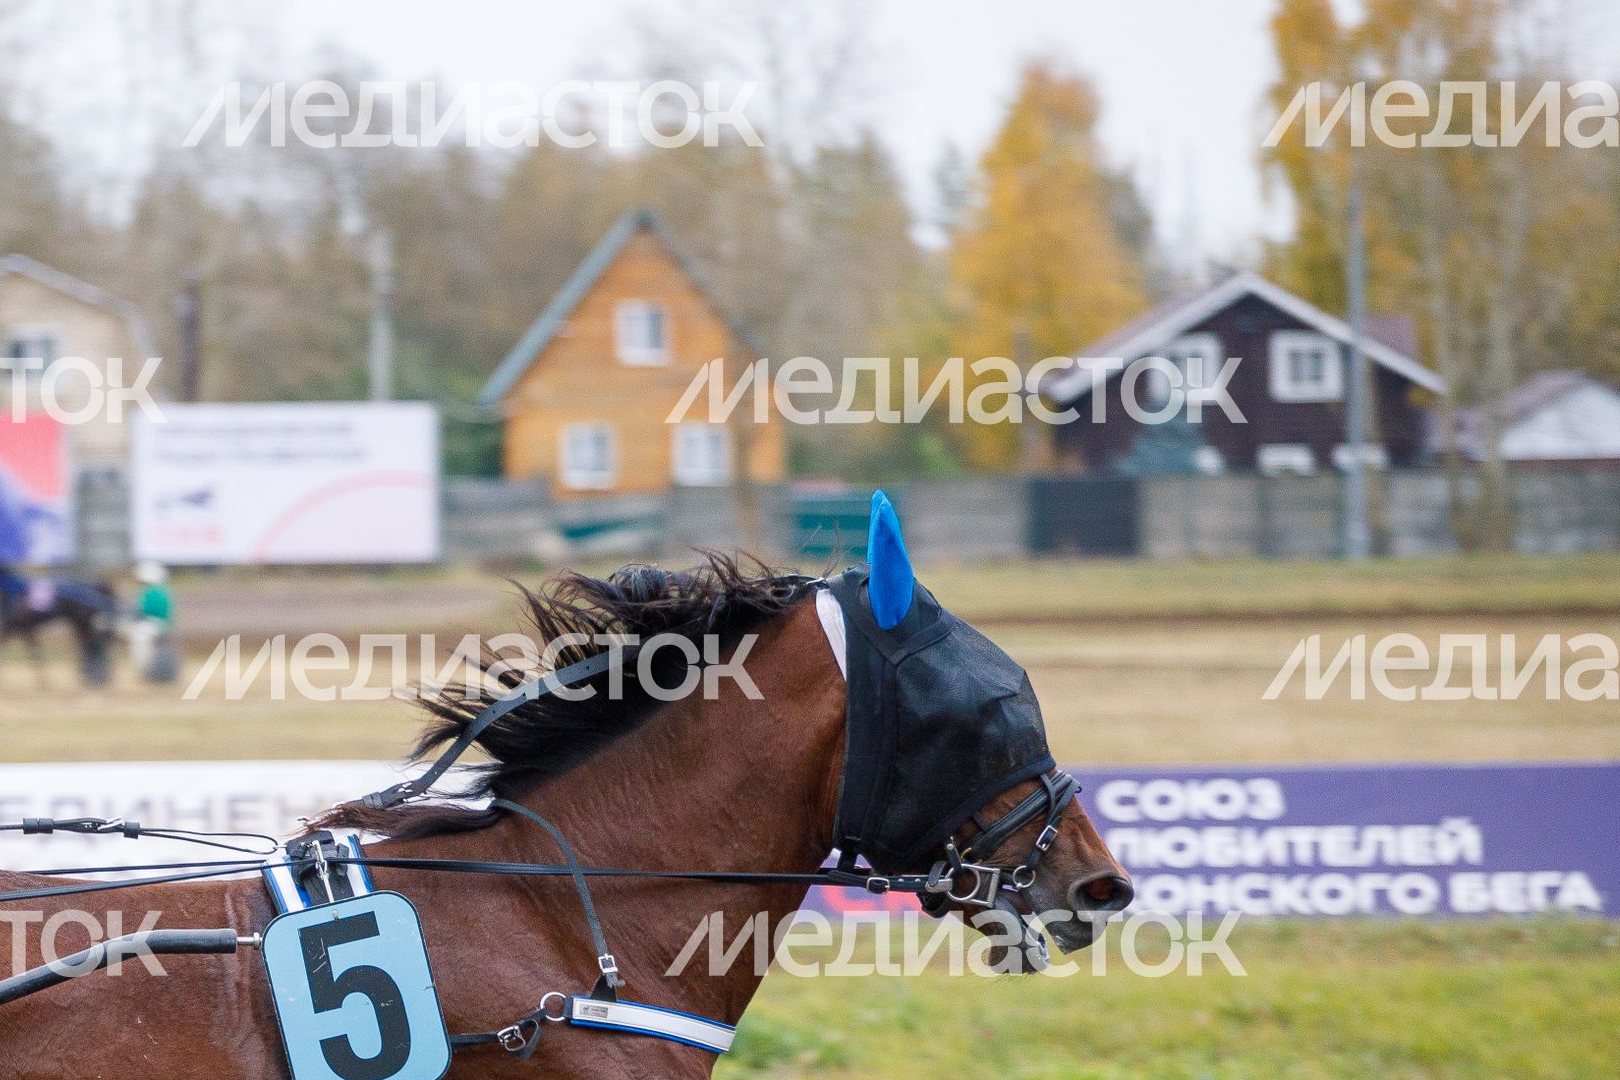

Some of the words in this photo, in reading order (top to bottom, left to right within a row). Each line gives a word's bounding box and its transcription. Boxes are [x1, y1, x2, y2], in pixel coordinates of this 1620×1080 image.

[1096, 779, 1285, 823] СОЮЗ
[1106, 816, 1484, 869] ЛЮБИТЕЛЕЙ
[1448, 869, 1605, 914] БЕГА
